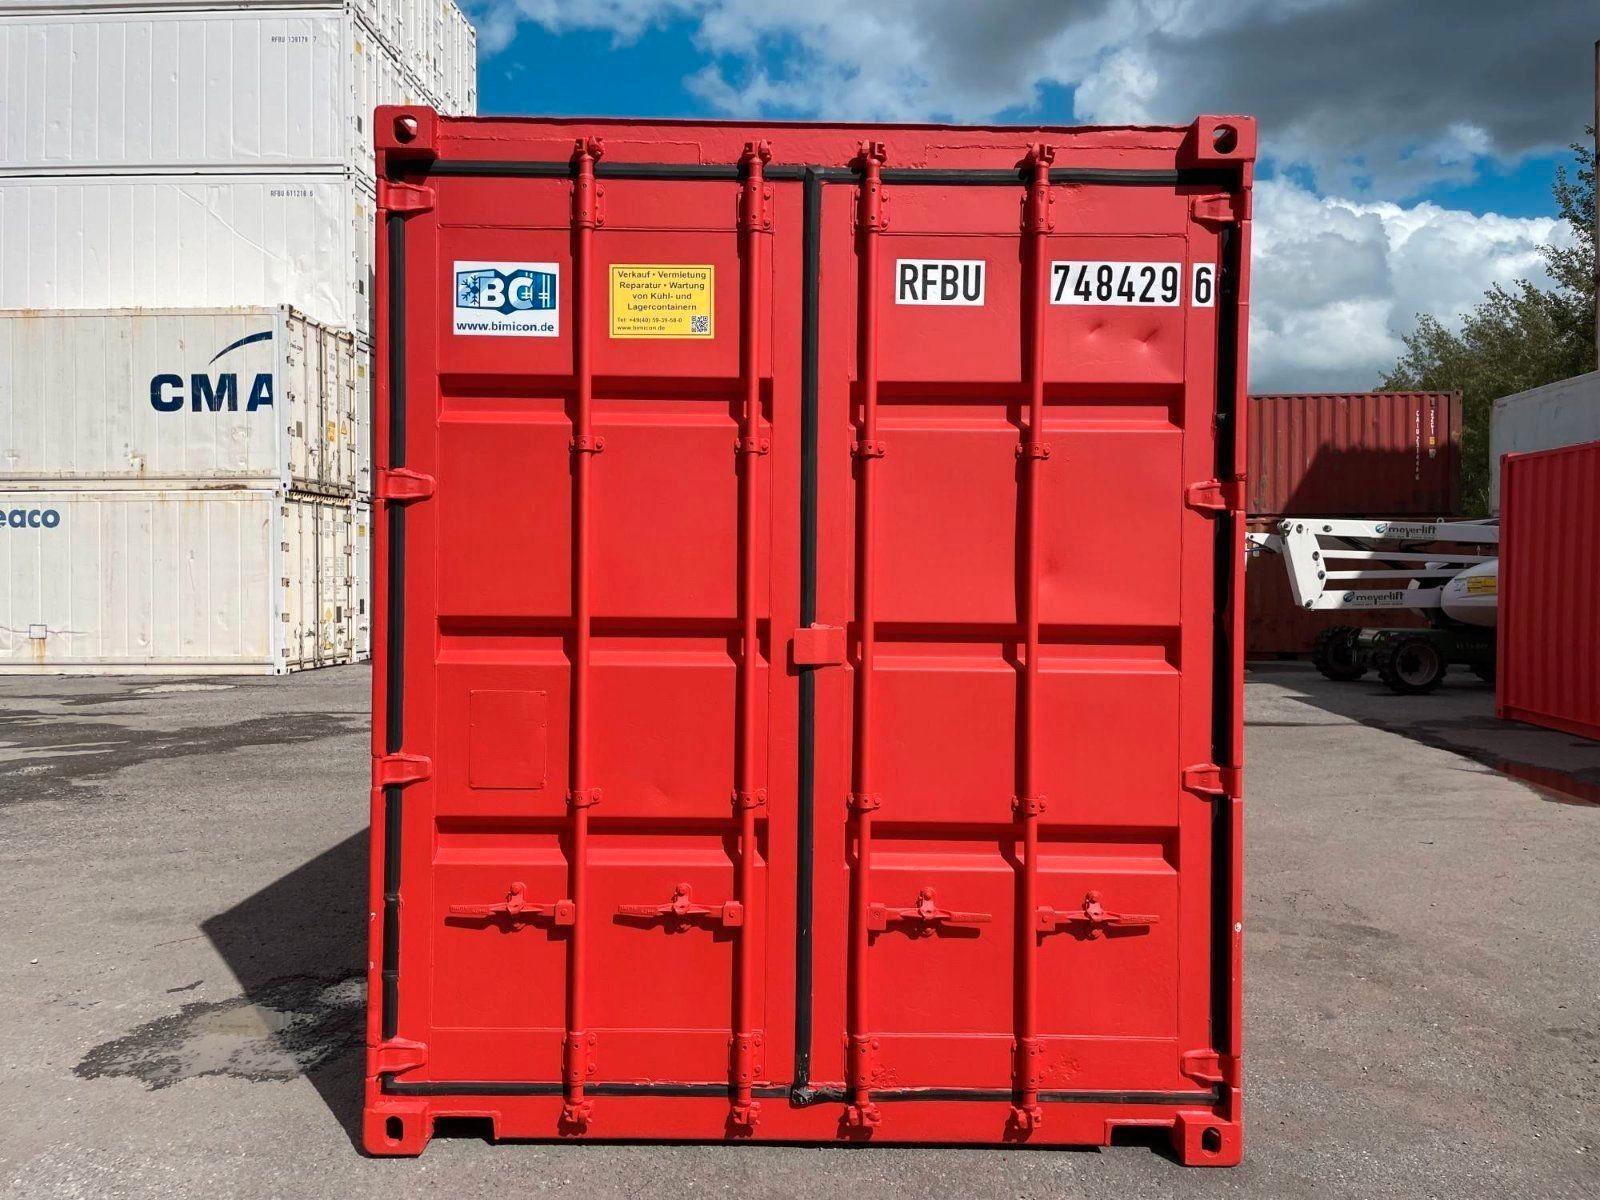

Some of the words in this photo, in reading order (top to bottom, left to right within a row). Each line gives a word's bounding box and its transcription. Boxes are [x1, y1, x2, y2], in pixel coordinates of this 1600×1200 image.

[618, 270, 650, 279] Verkauf
[658, 270, 707, 280] Vermietung
[619, 282, 662, 290] Reparatur
[669, 282, 705, 290] Wartung
[899, 264, 982, 301] RFBU
[1053, 265, 1178, 303] 748429
[1195, 267, 1212, 303] 6
[675, 292, 692, 300] und
[627, 303, 697, 312] Lagercontainern
[456, 321, 555, 332] www.bimicon.de
[150, 373, 273, 412] CMA
[1388, 525, 1436, 537] meyerlift
[1356, 591, 1404, 605] meyerlift
